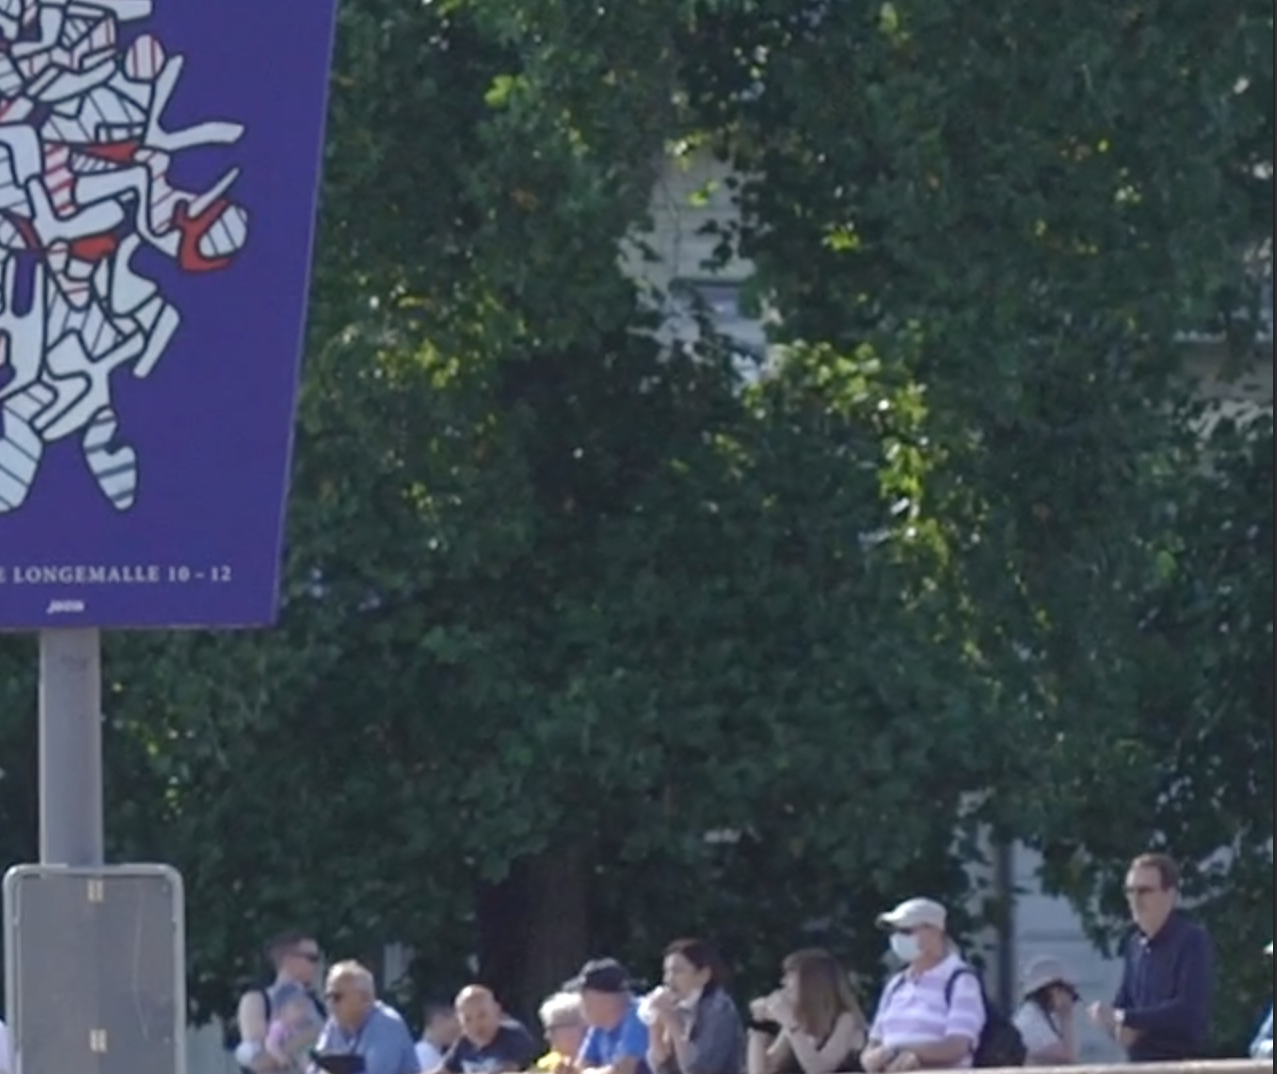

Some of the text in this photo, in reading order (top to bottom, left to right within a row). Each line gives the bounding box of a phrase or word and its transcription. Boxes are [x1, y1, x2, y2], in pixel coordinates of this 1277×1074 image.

[13, 564, 160, 585] LONGEMALLE
[168, 564, 190, 583] 10
[211, 564, 232, 583] 12
